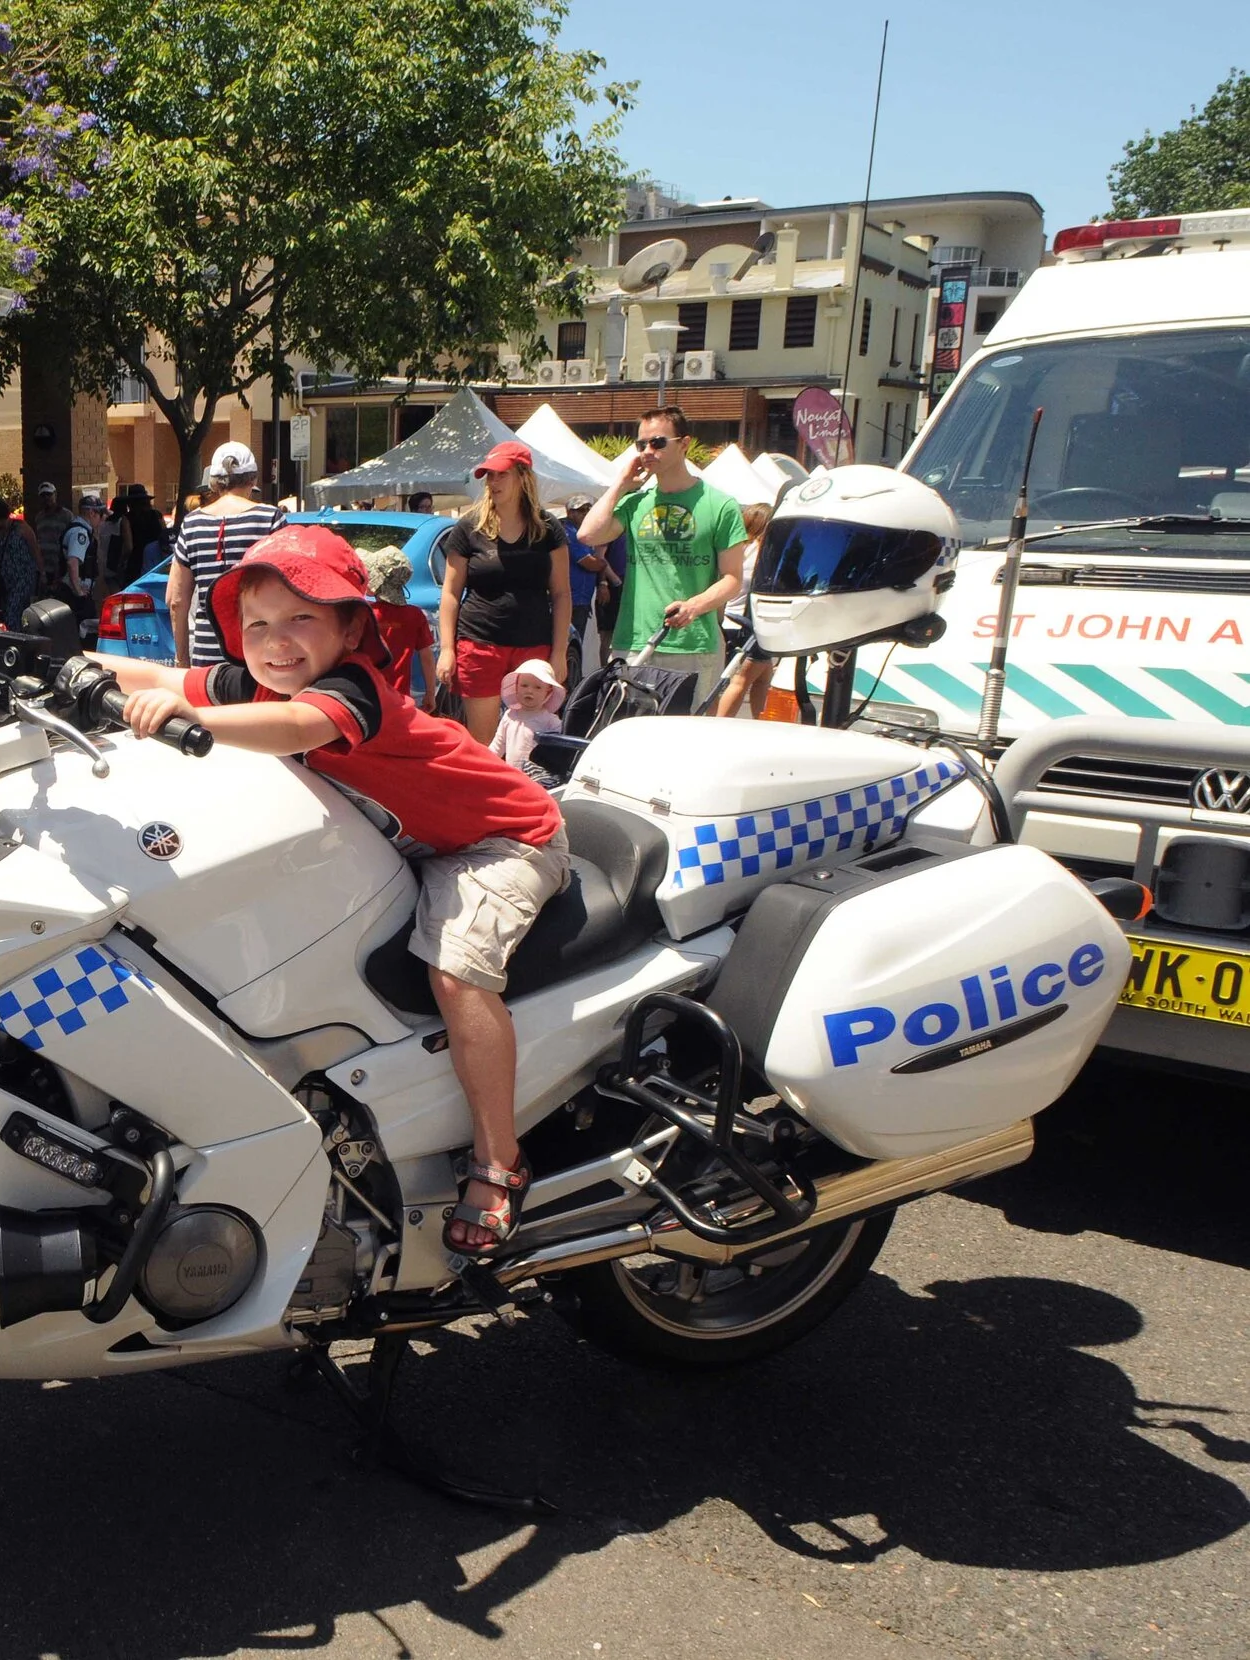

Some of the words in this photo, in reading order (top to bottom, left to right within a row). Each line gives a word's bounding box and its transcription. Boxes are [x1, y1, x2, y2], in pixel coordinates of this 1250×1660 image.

[292, 419, 309, 431] 2P
[637, 543, 692, 555] SEATTLE
[972, 614, 1036, 639] ST
[1047, 614, 1192, 642] JOHN
[823, 943, 1105, 1068] Police
[1145, 996, 1207, 1016] SOUTH
[1218, 1008, 1250, 1025] WAL
[959, 1039, 992, 1057] YAMAHA
[183, 1264, 227, 1279] YAMAHA
